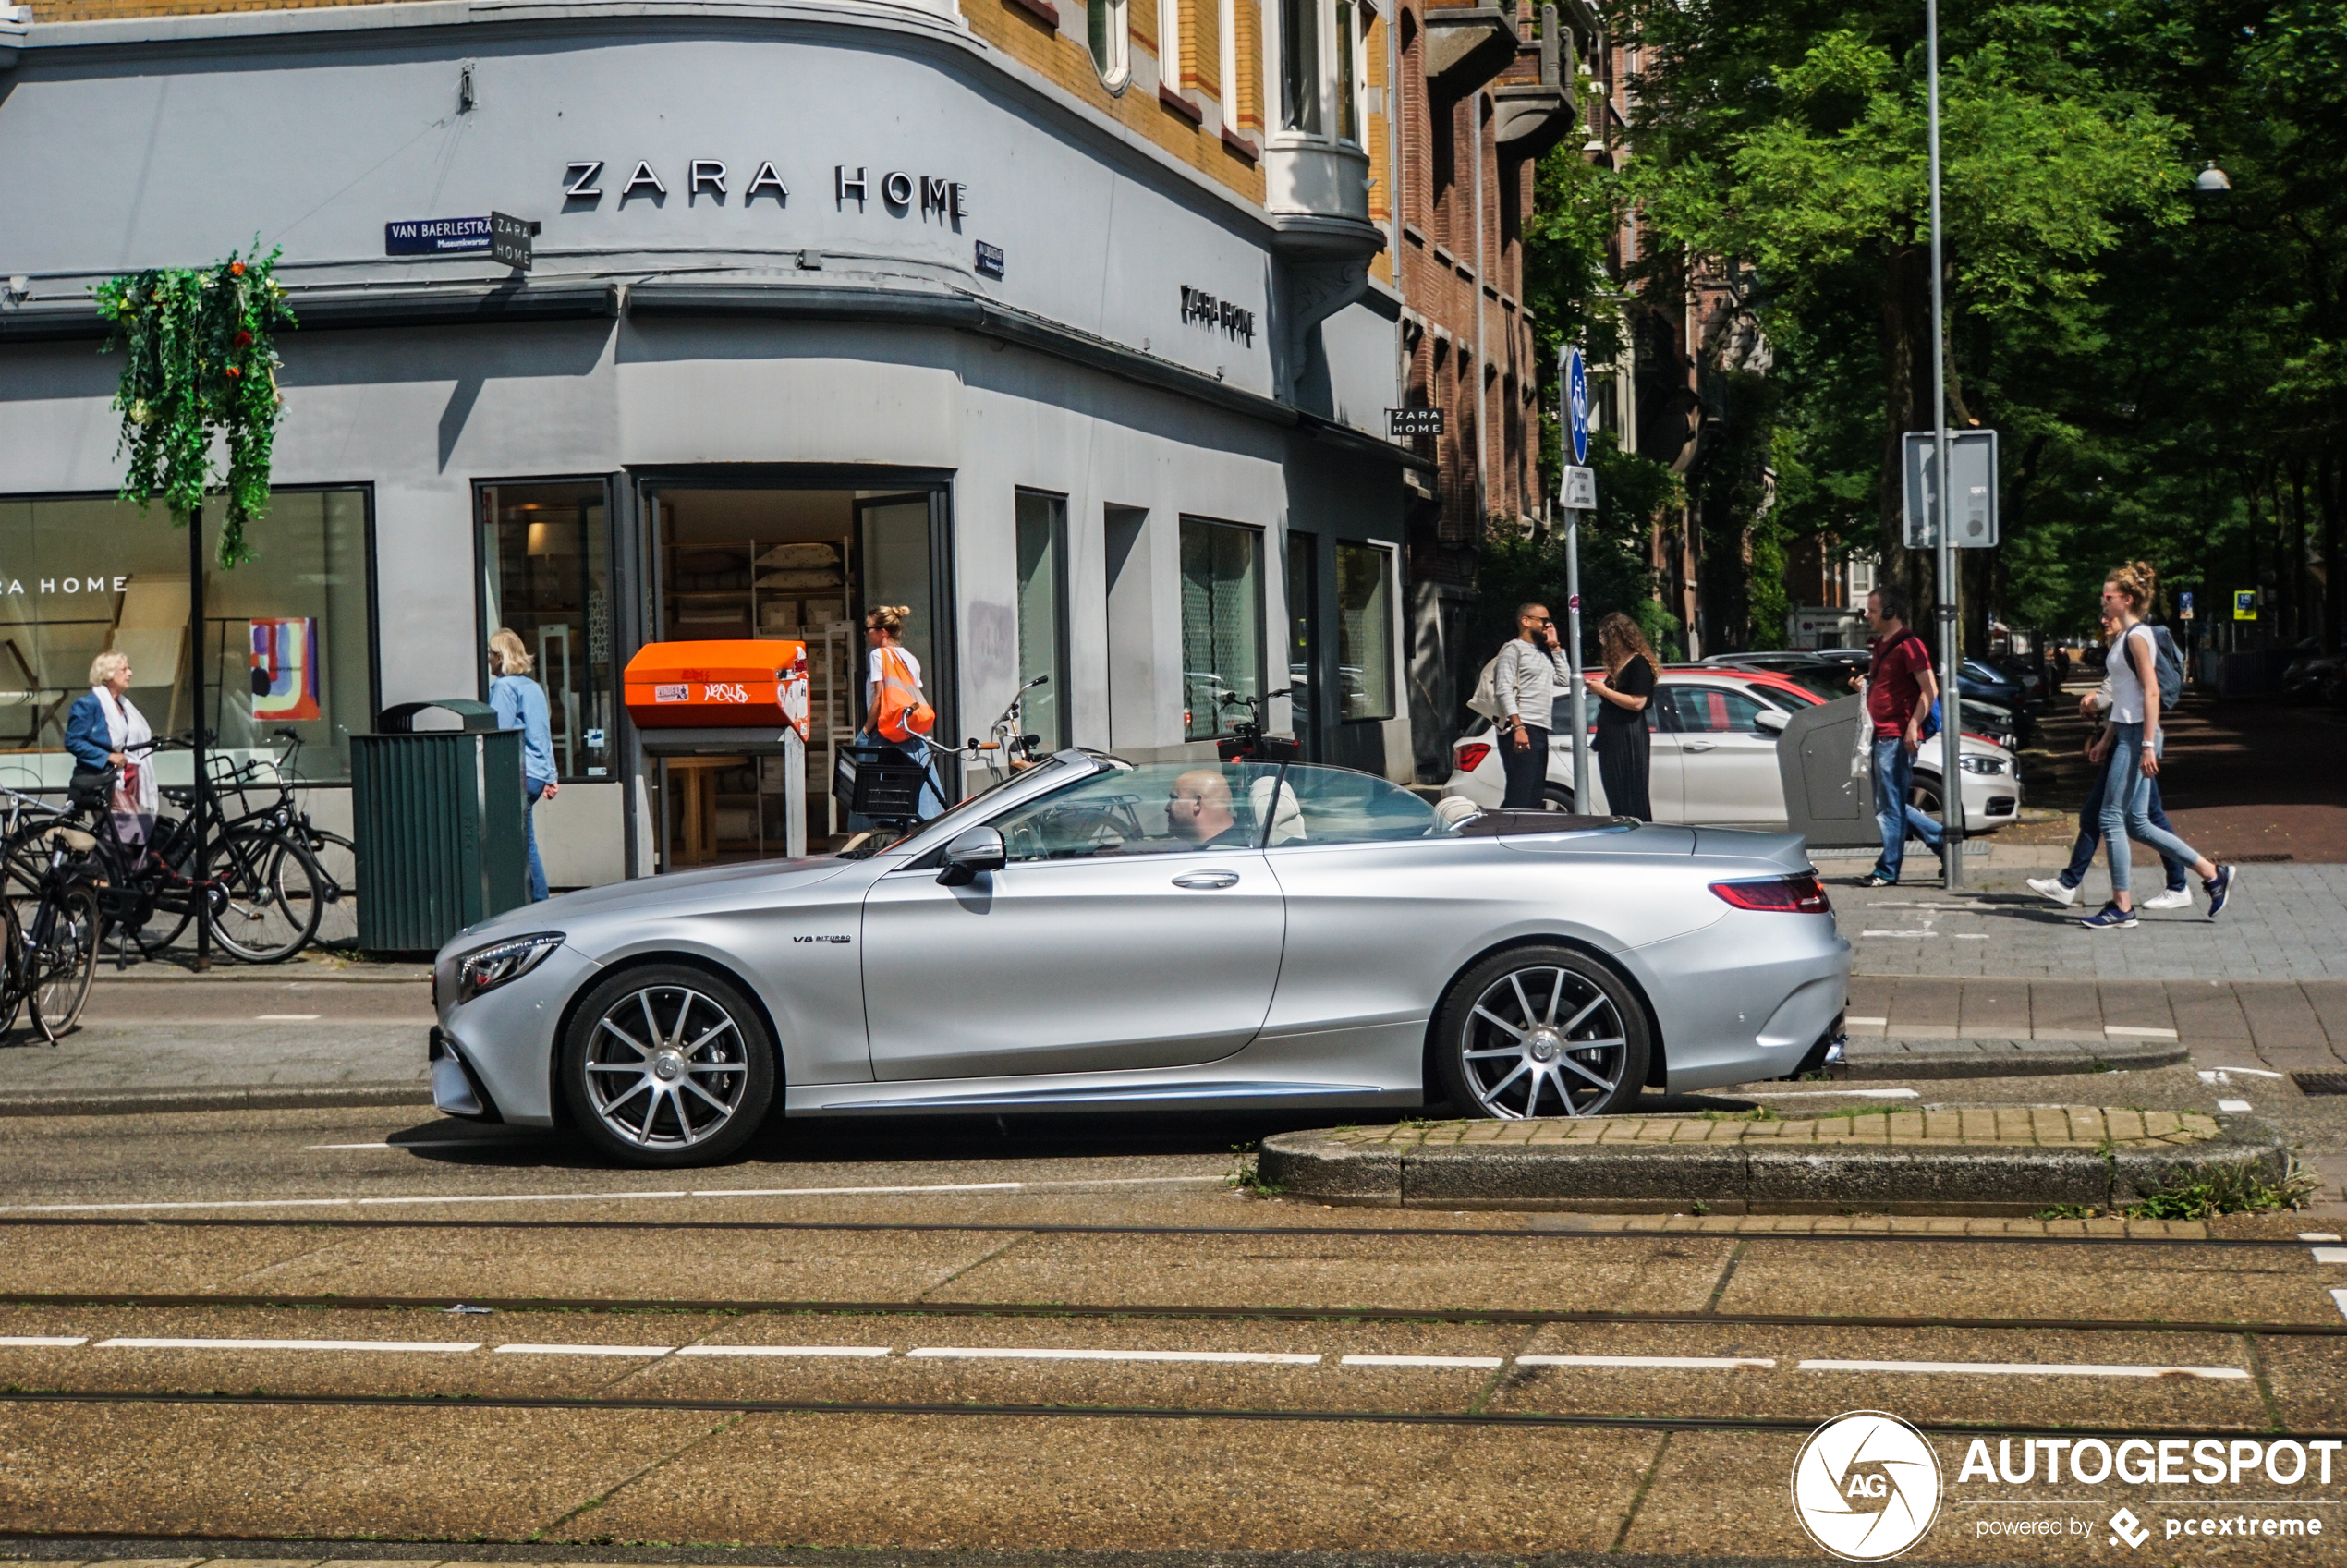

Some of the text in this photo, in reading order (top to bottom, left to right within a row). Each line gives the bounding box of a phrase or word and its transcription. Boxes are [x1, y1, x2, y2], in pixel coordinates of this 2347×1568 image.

[565, 160, 968, 217] ZARA HOME
[392, 225, 417, 238] VAN
[497, 218, 529, 239] ZARA
[437, 238, 490, 249] Museumkwartier
[496, 243, 530, 265] HOME
[1181, 285, 1257, 336] ZARA HOME
[1395, 411, 1440, 420] ZARA
[1393, 424, 1441, 432] HOME
[41, 576, 128, 594] HOME
